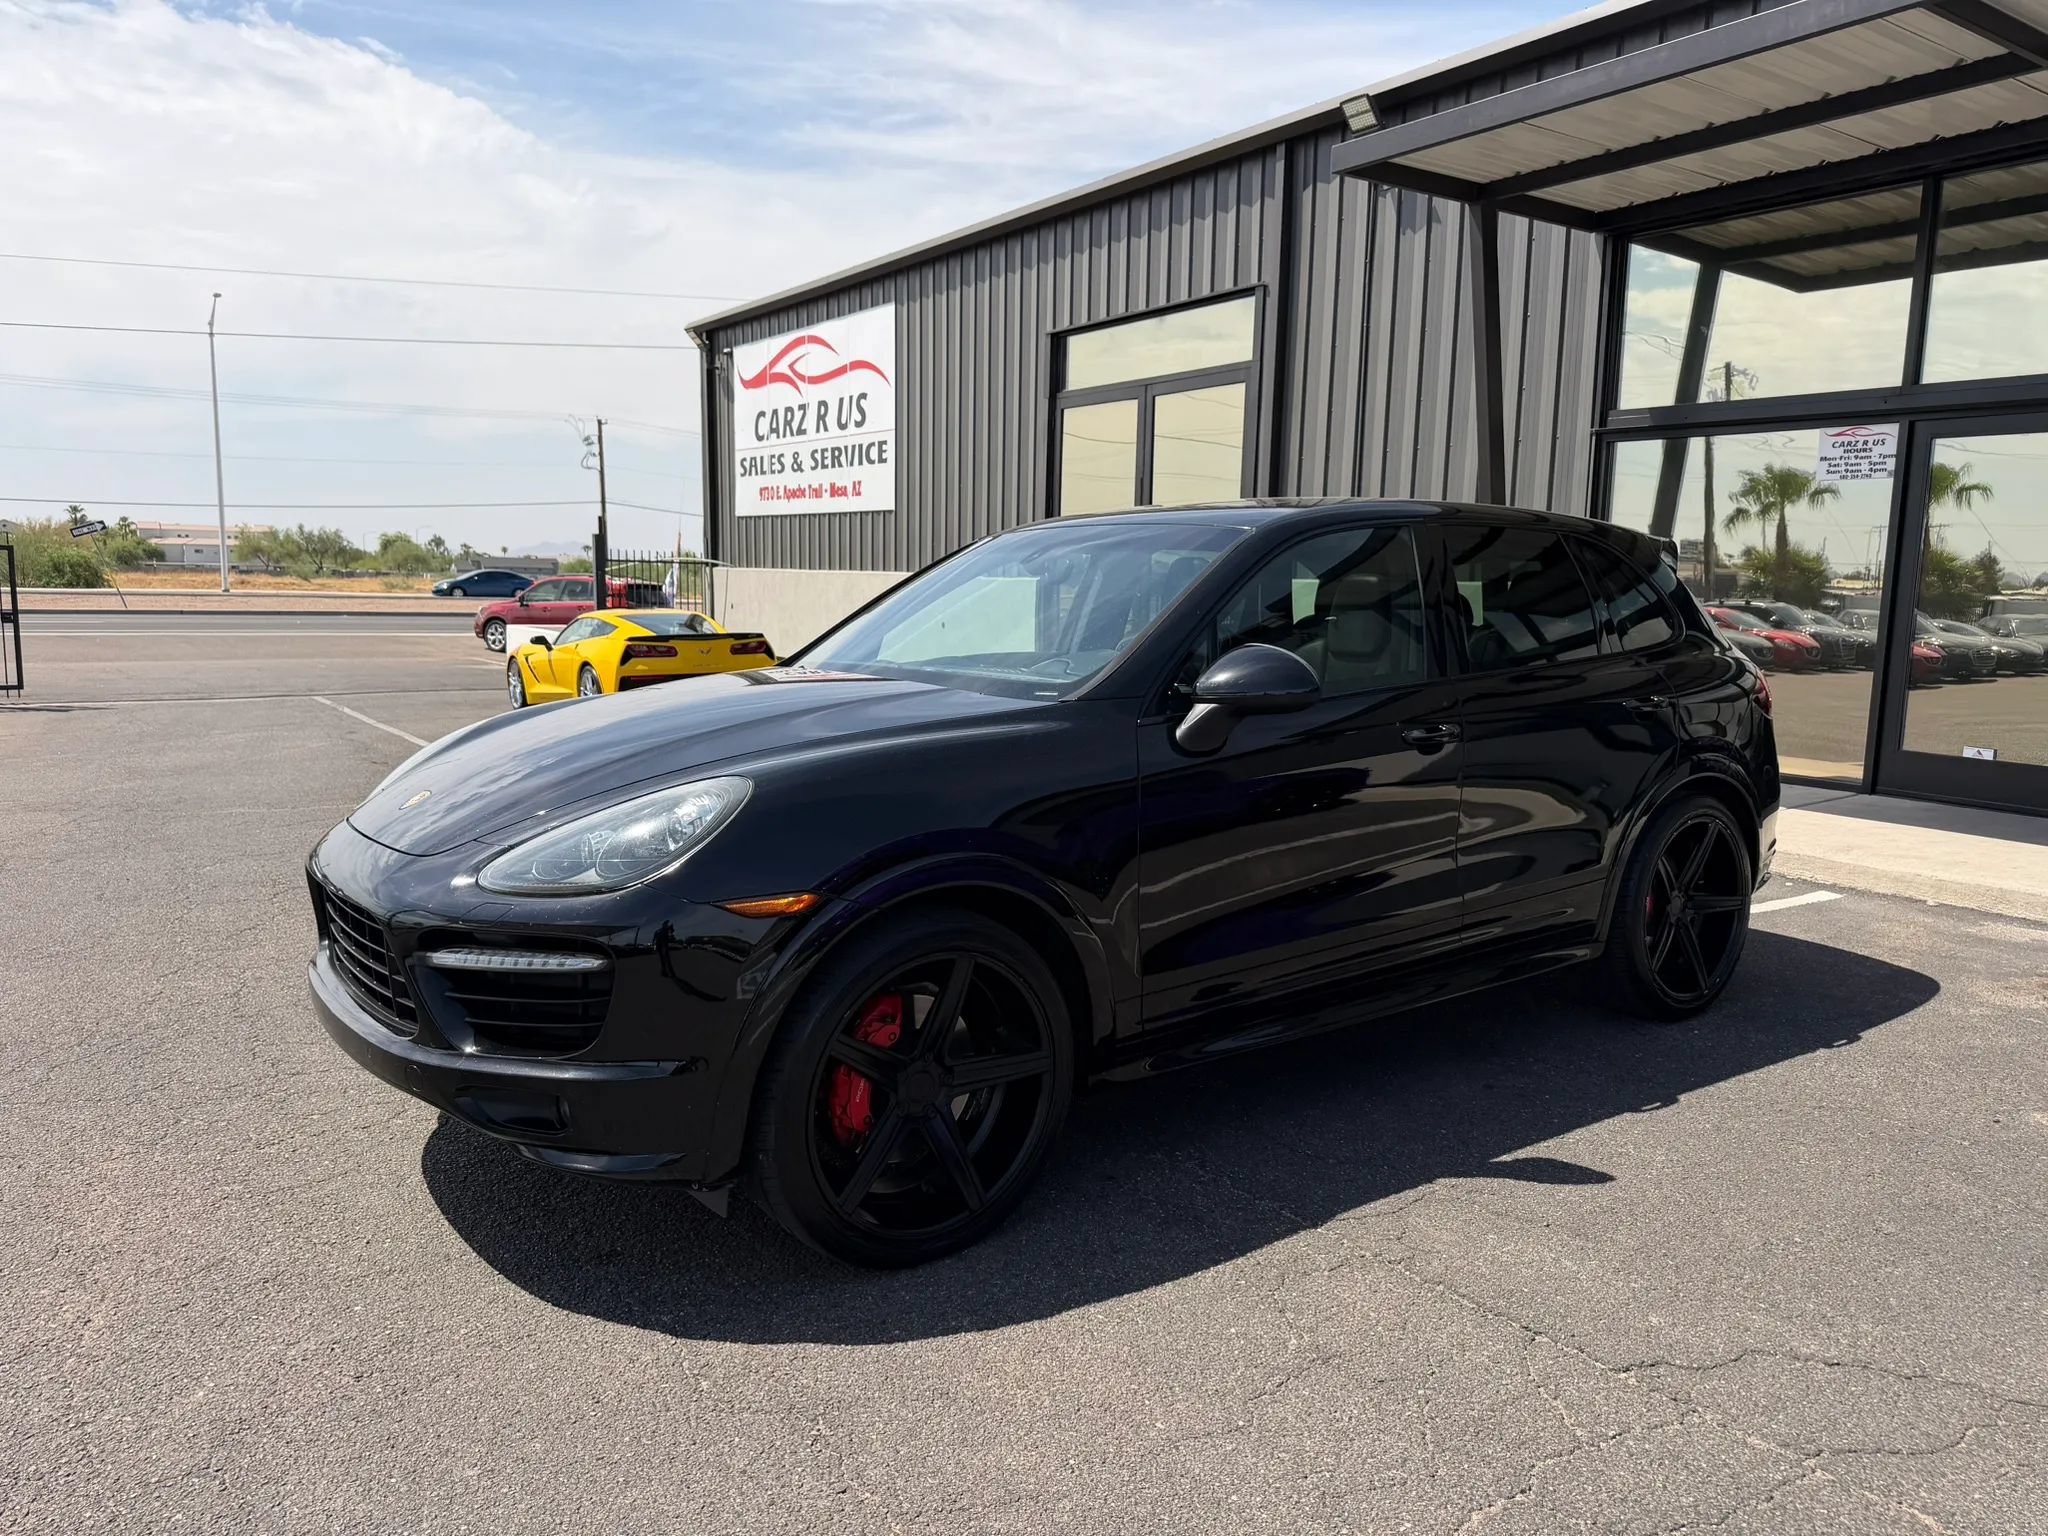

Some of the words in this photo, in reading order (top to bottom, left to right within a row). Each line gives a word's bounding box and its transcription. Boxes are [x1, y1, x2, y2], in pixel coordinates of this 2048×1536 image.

[754, 402, 809, 441] CARZ
[815, 399, 829, 434] R
[836, 392, 868, 431] US
[1832, 440, 1860, 448] CARZ
[1872, 438, 1887, 447] US
[740, 453, 785, 477] SALES
[791, 451, 804, 473] &
[810, 440, 888, 471] SERVICE
[783, 484, 806, 503] Apache
[808, 483, 823, 499] Trail
[852, 480, 862, 497] AZ
